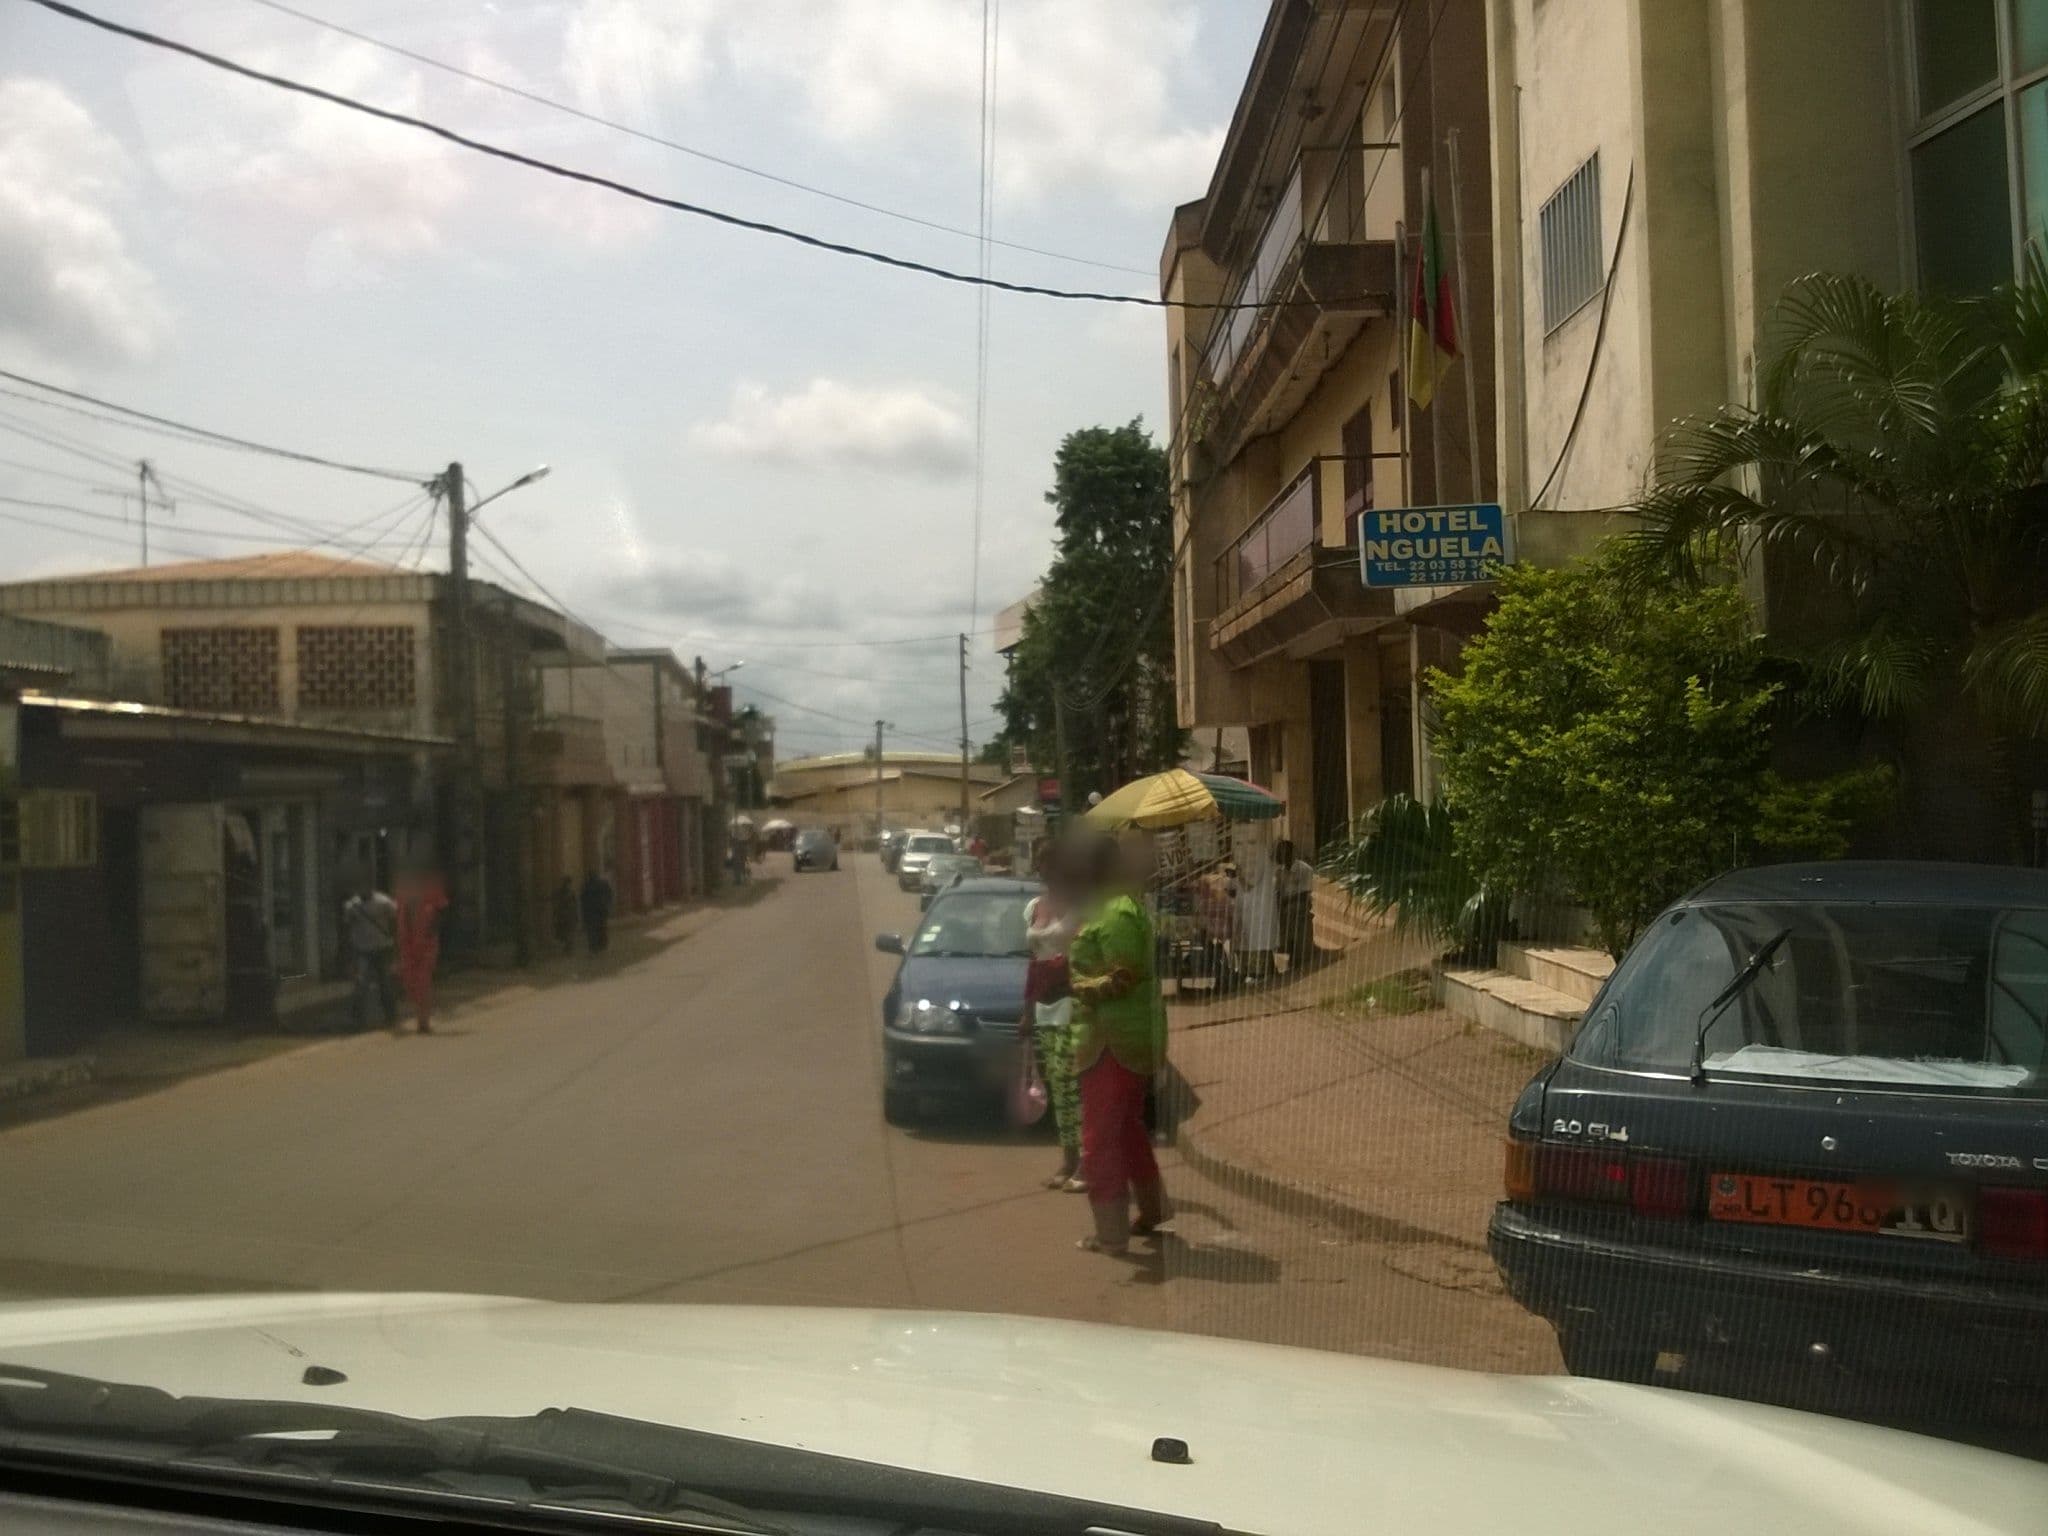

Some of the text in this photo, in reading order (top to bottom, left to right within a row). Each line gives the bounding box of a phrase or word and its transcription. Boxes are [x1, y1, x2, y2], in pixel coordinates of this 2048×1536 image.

[1378, 510, 1488, 534] HOTEL
[1366, 536, 1503, 560] NGUELA
[1376, 562, 1406, 572] TEL.
[1409, 560, 1426, 570] 22
[1429, 560, 1446, 570] 03
[1409, 572, 1426, 582] 22
[1430, 571, 1446, 582] 17
[1945, 1152, 2021, 1168] TOYOTA
[1746, 1180, 1796, 1218] LT
